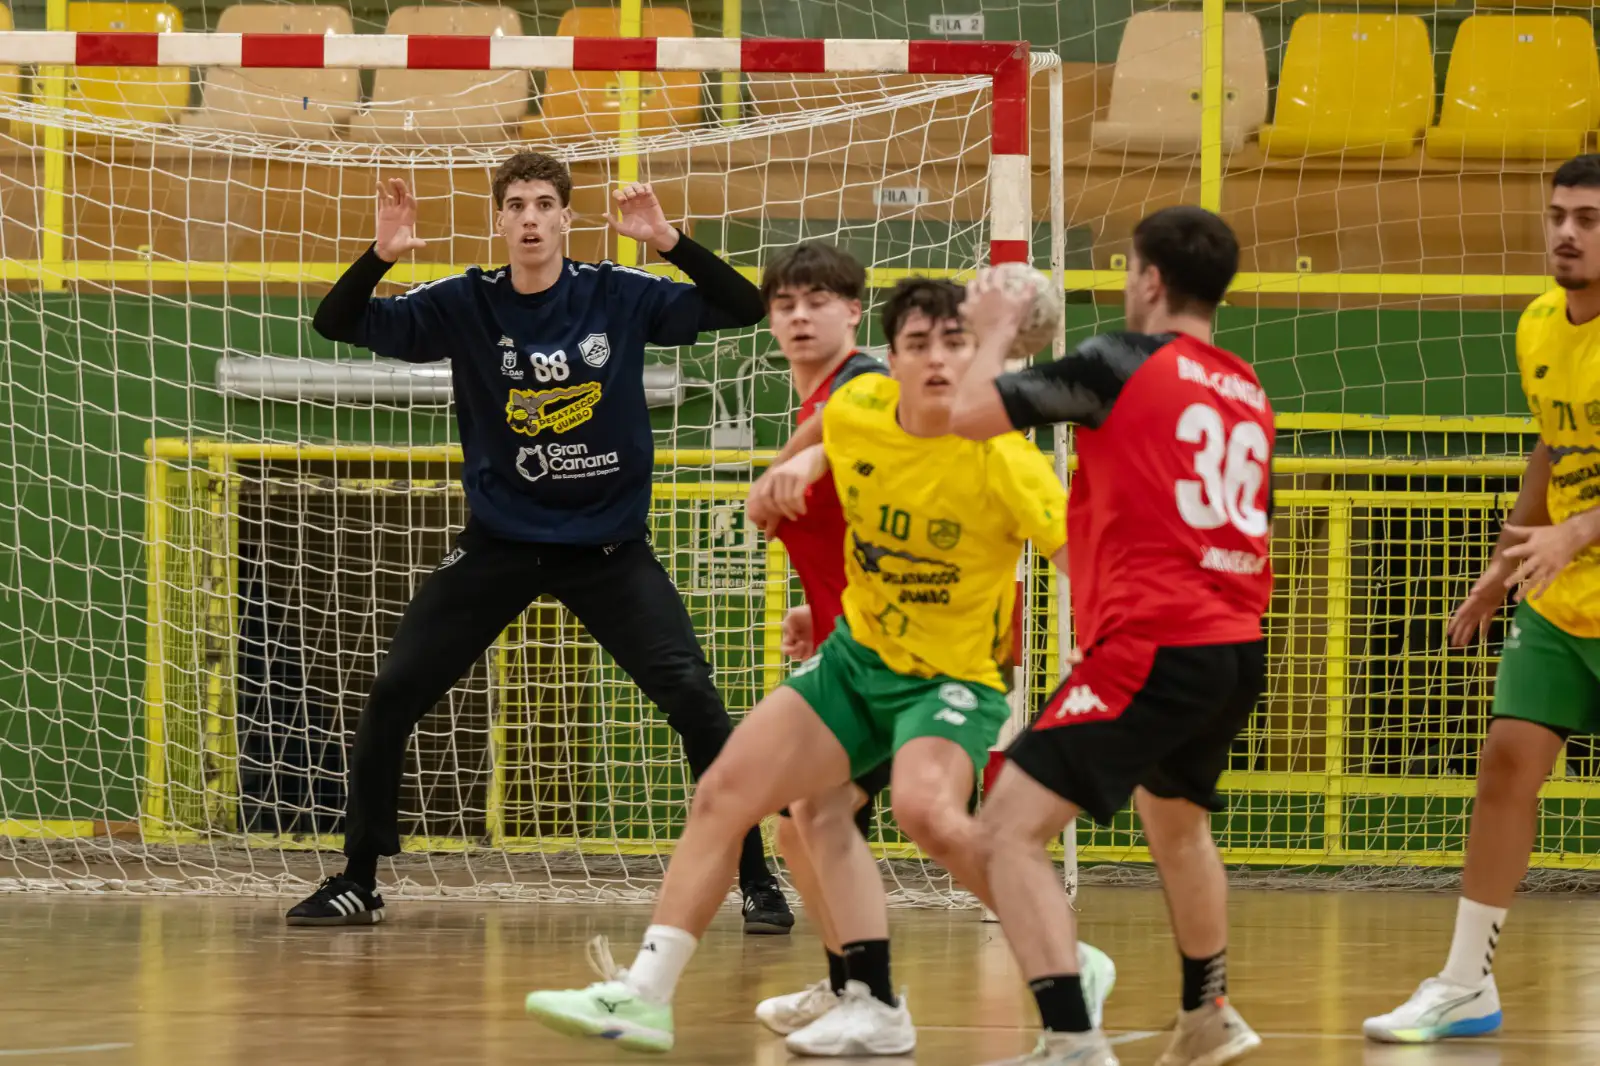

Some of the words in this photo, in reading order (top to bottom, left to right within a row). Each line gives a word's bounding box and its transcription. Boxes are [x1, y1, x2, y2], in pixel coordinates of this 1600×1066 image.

[970, 19, 979, 31] 2
[880, 190, 907, 203] FILA
[530, 350, 570, 383] 88
[539, 393, 599, 426] DESATASCOS
[556, 409, 590, 431] JUMBO
[1553, 399, 1577, 431] 71
[547, 443, 588, 457] Gran
[549, 451, 619, 471] Canaria
[1175, 402, 1270, 537] 36
[879, 504, 911, 541] 10
